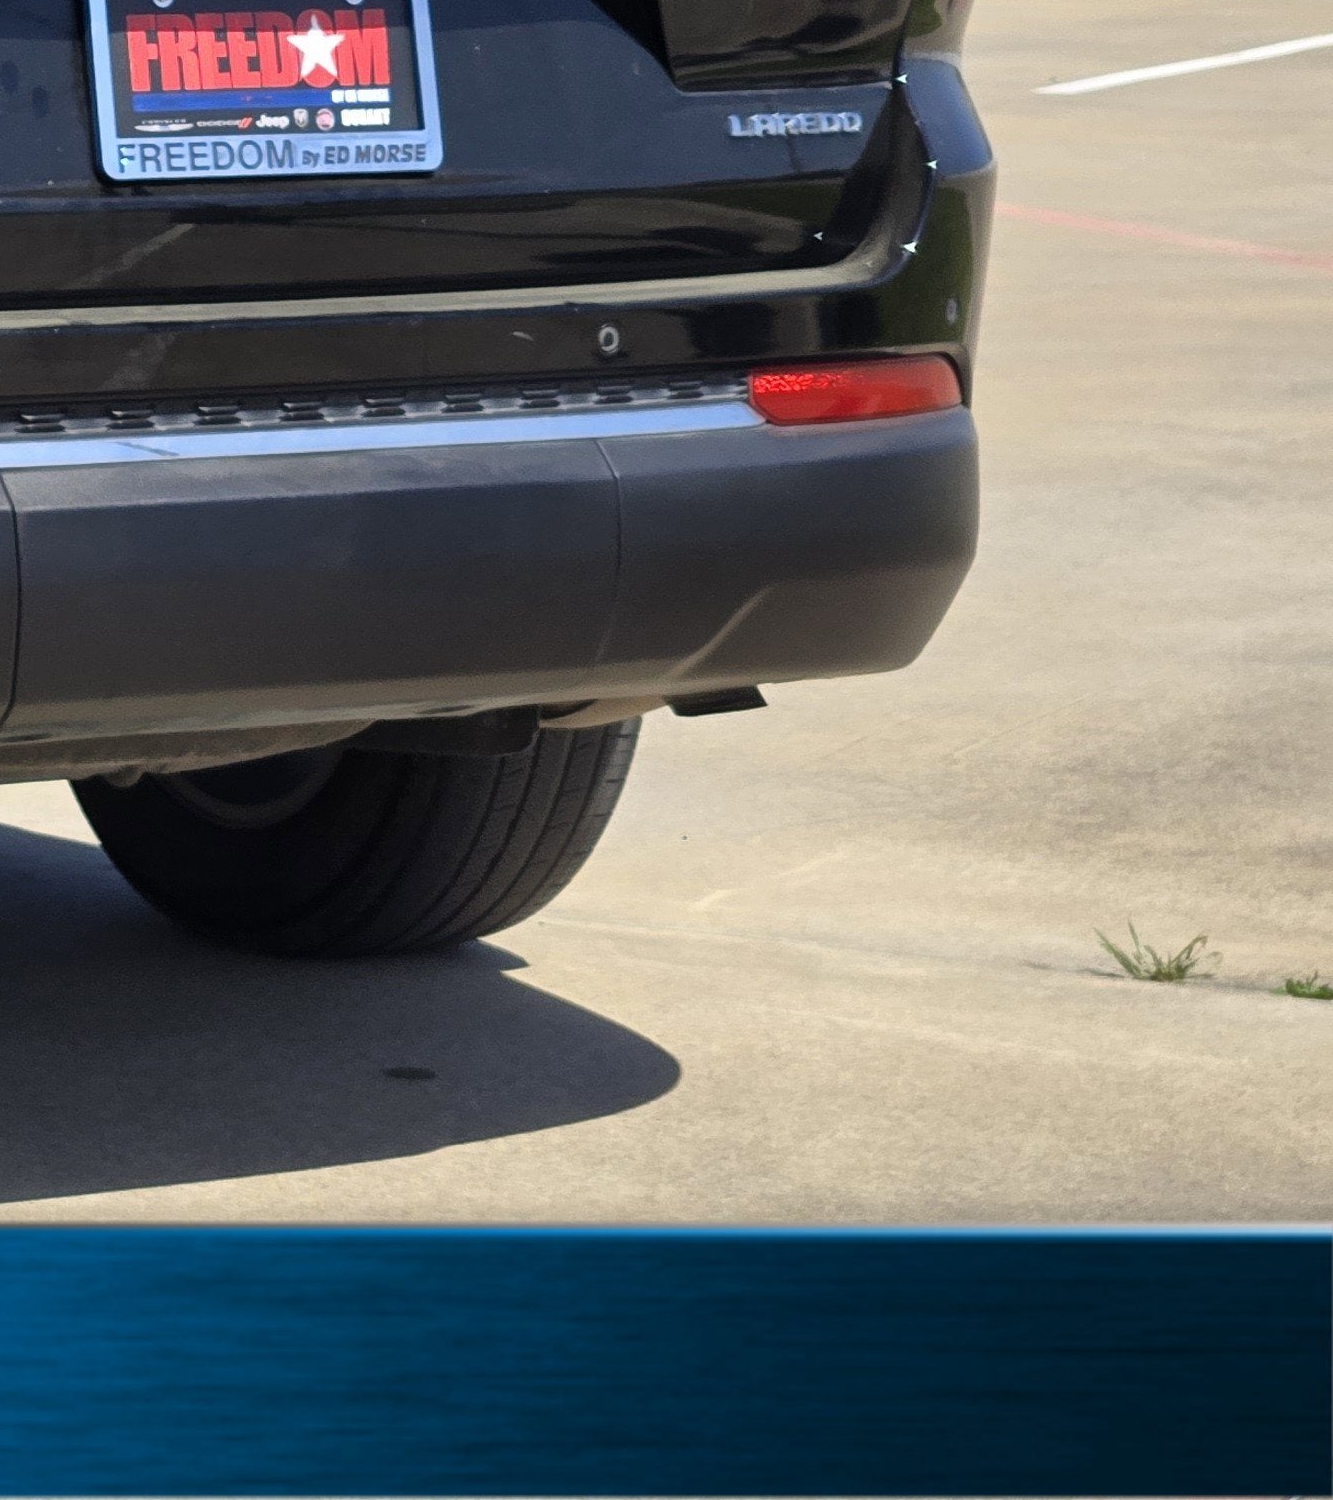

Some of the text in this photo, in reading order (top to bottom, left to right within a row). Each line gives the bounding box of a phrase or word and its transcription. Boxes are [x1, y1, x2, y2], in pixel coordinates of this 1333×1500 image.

[126, 8, 391, 91] FREEDOM
[255, 113, 290, 129] Jeep
[117, 139, 295, 173] FREEDOM
[324, 145, 350, 165] ED
[354, 143, 427, 164] MORSE
